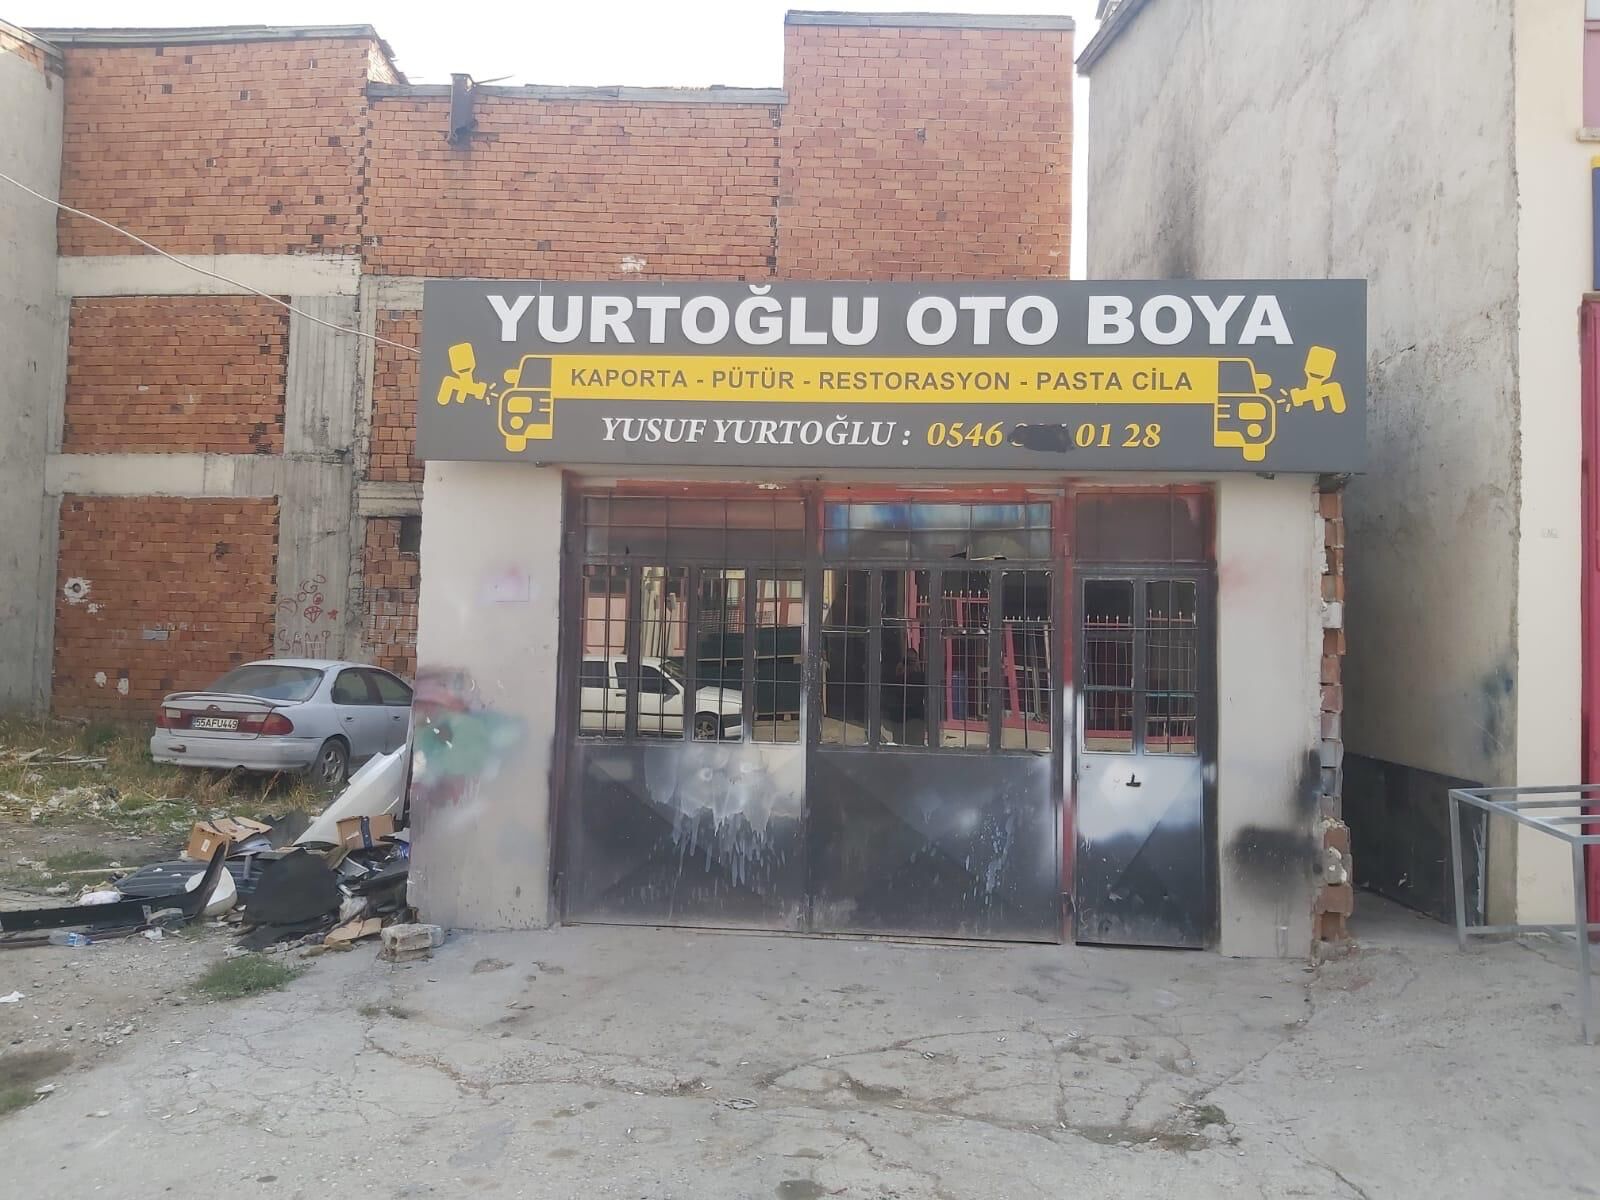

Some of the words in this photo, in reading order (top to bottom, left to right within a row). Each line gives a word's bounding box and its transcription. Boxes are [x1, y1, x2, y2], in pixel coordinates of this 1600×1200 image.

[487, 284, 879, 346] YURTOĞLU
[906, 295, 1059, 346] OTO
[1087, 294, 1294, 345] BOYA
[571, 368, 688, 388] KAPORTA
[712, 366, 794, 390] PÜTÜR
[819, 371, 1010, 391] RESTORASYON
[1036, 371, 1123, 391] PASTA
[1132, 367, 1193, 391] CİLA
[601, 417, 705, 443] YUSUF
[711, 414, 897, 446] YURTOĞLU
[927, 422, 1003, 448] 0546
[1075, 423, 1111, 448] 01
[1121, 423, 1161, 448] 28
